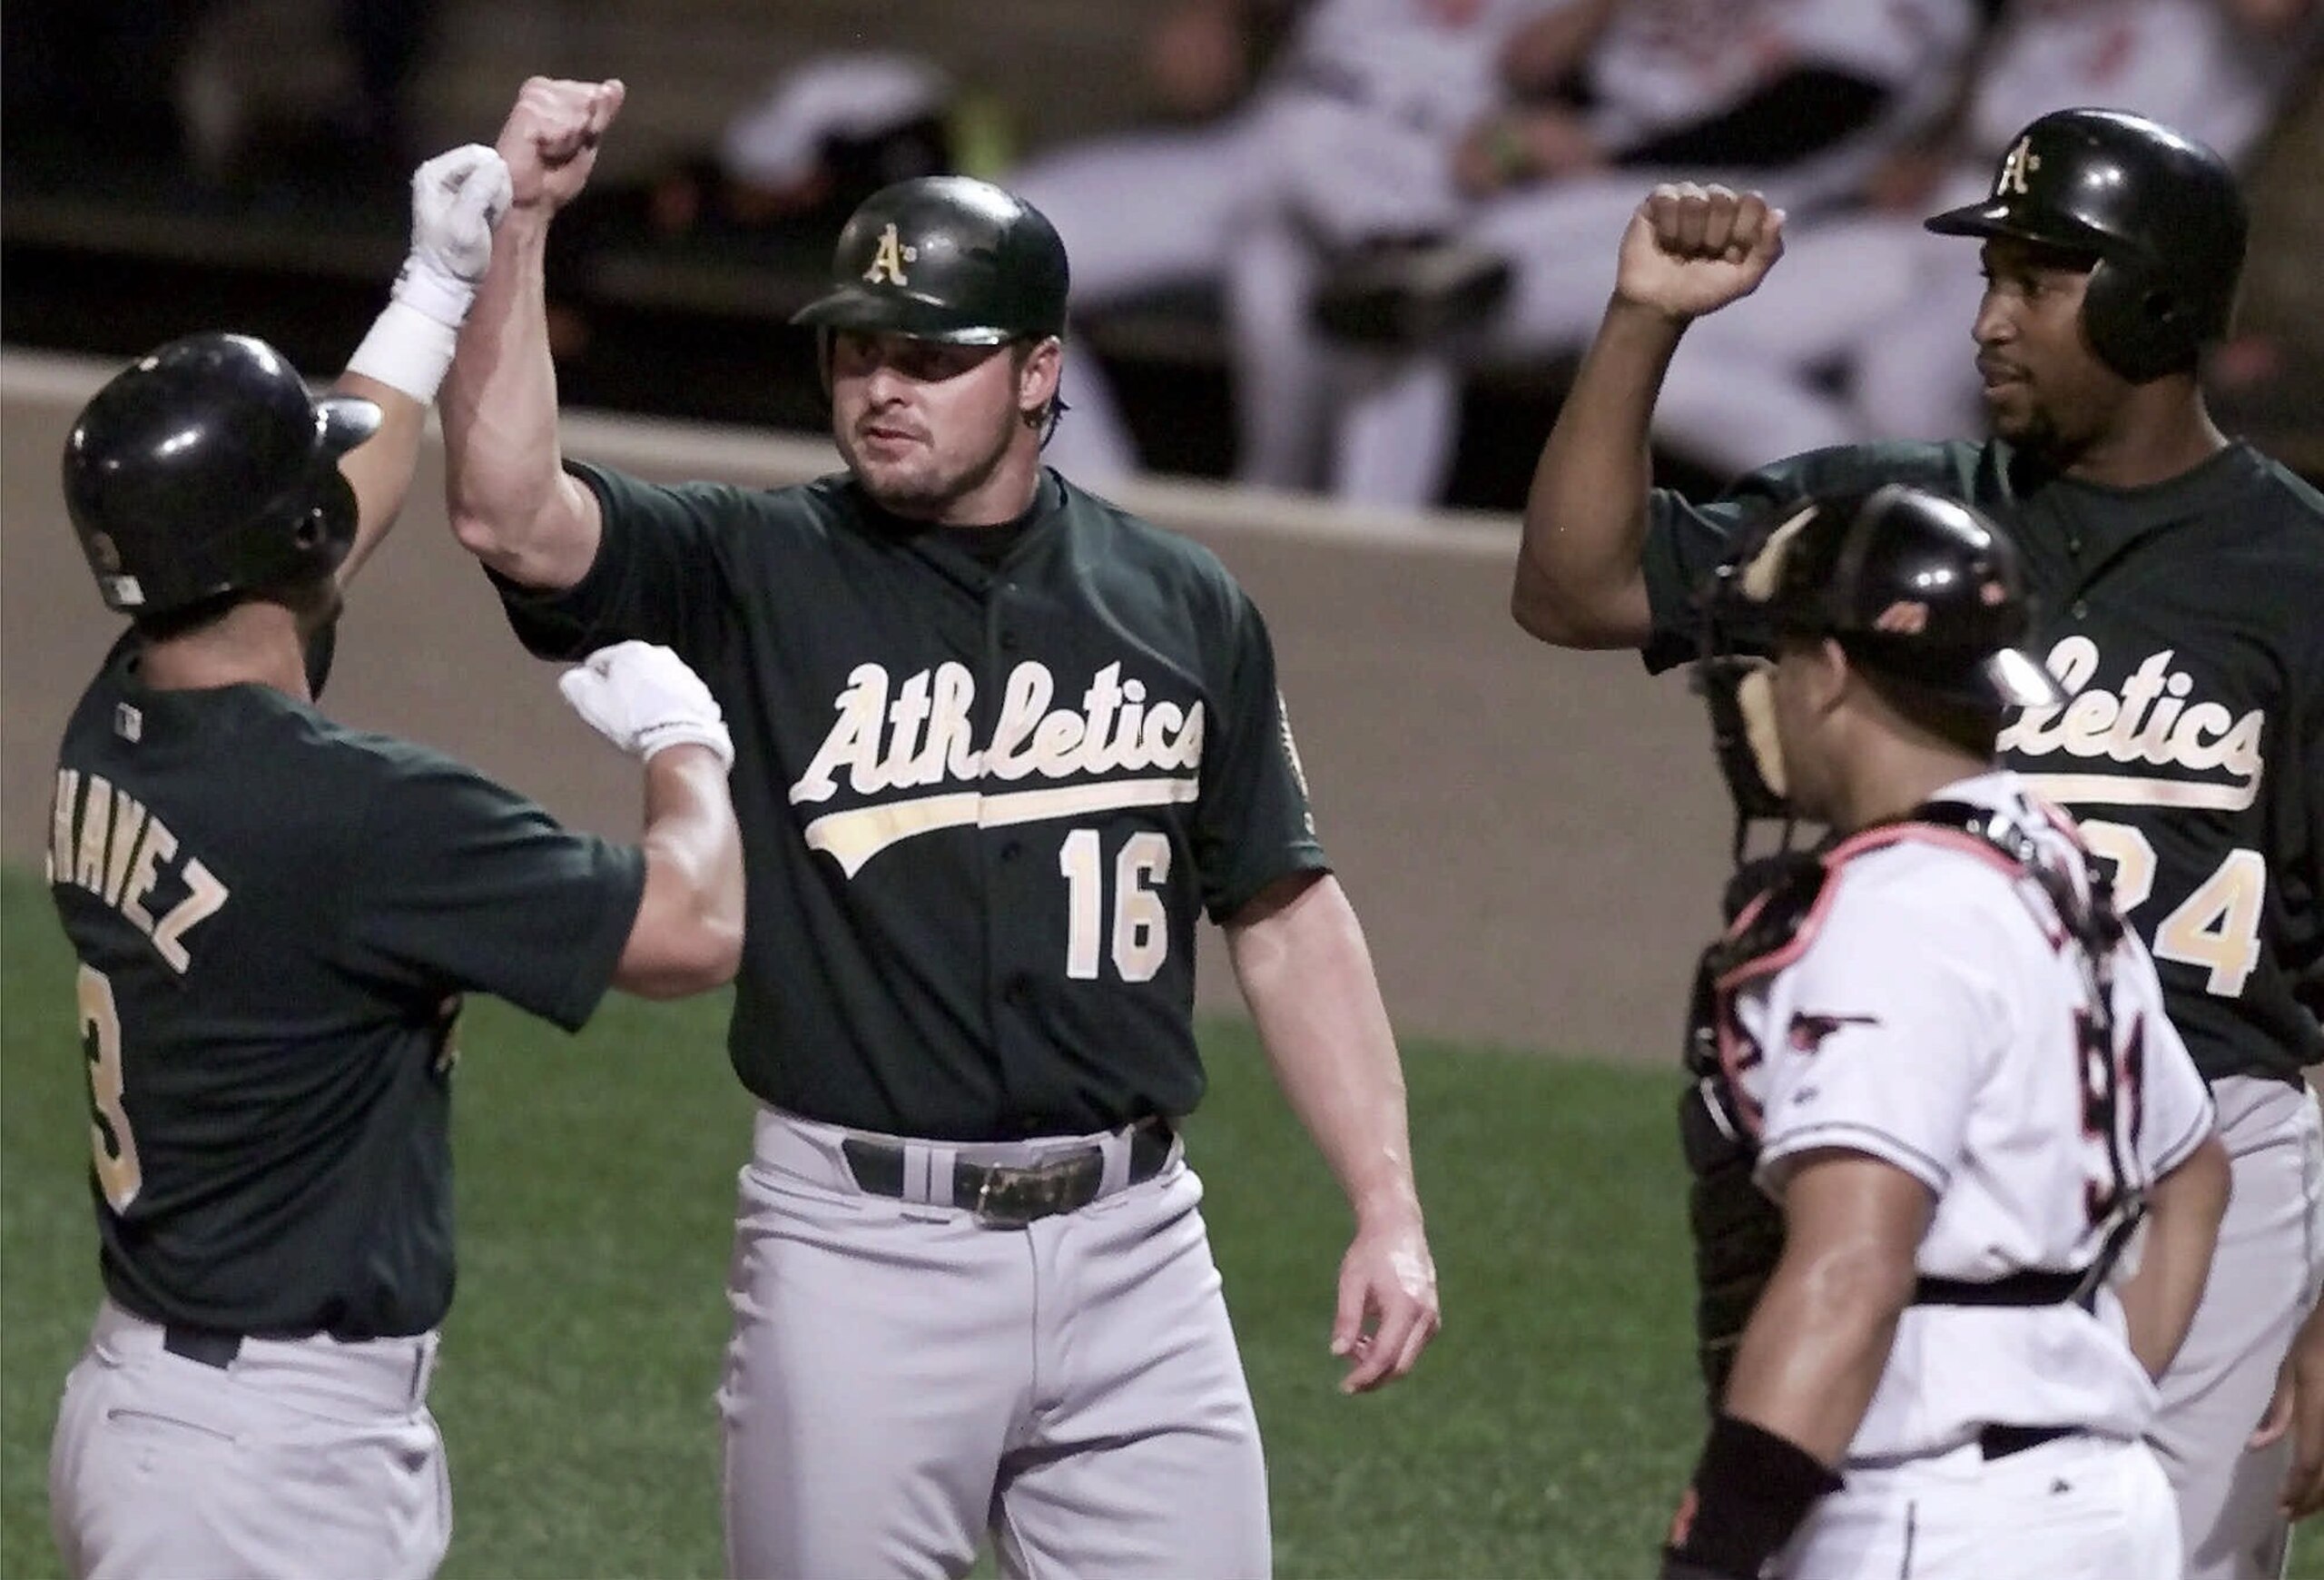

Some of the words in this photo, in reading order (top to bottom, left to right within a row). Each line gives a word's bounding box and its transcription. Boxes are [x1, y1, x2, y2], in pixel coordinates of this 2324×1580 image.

[789, 661, 1204, 805] Athletics
[1997, 636, 2266, 775] letics
[45, 768, 230, 973] HAVEZ
[1059, 829, 1171, 982] 16
[76, 962, 143, 1215] 3
